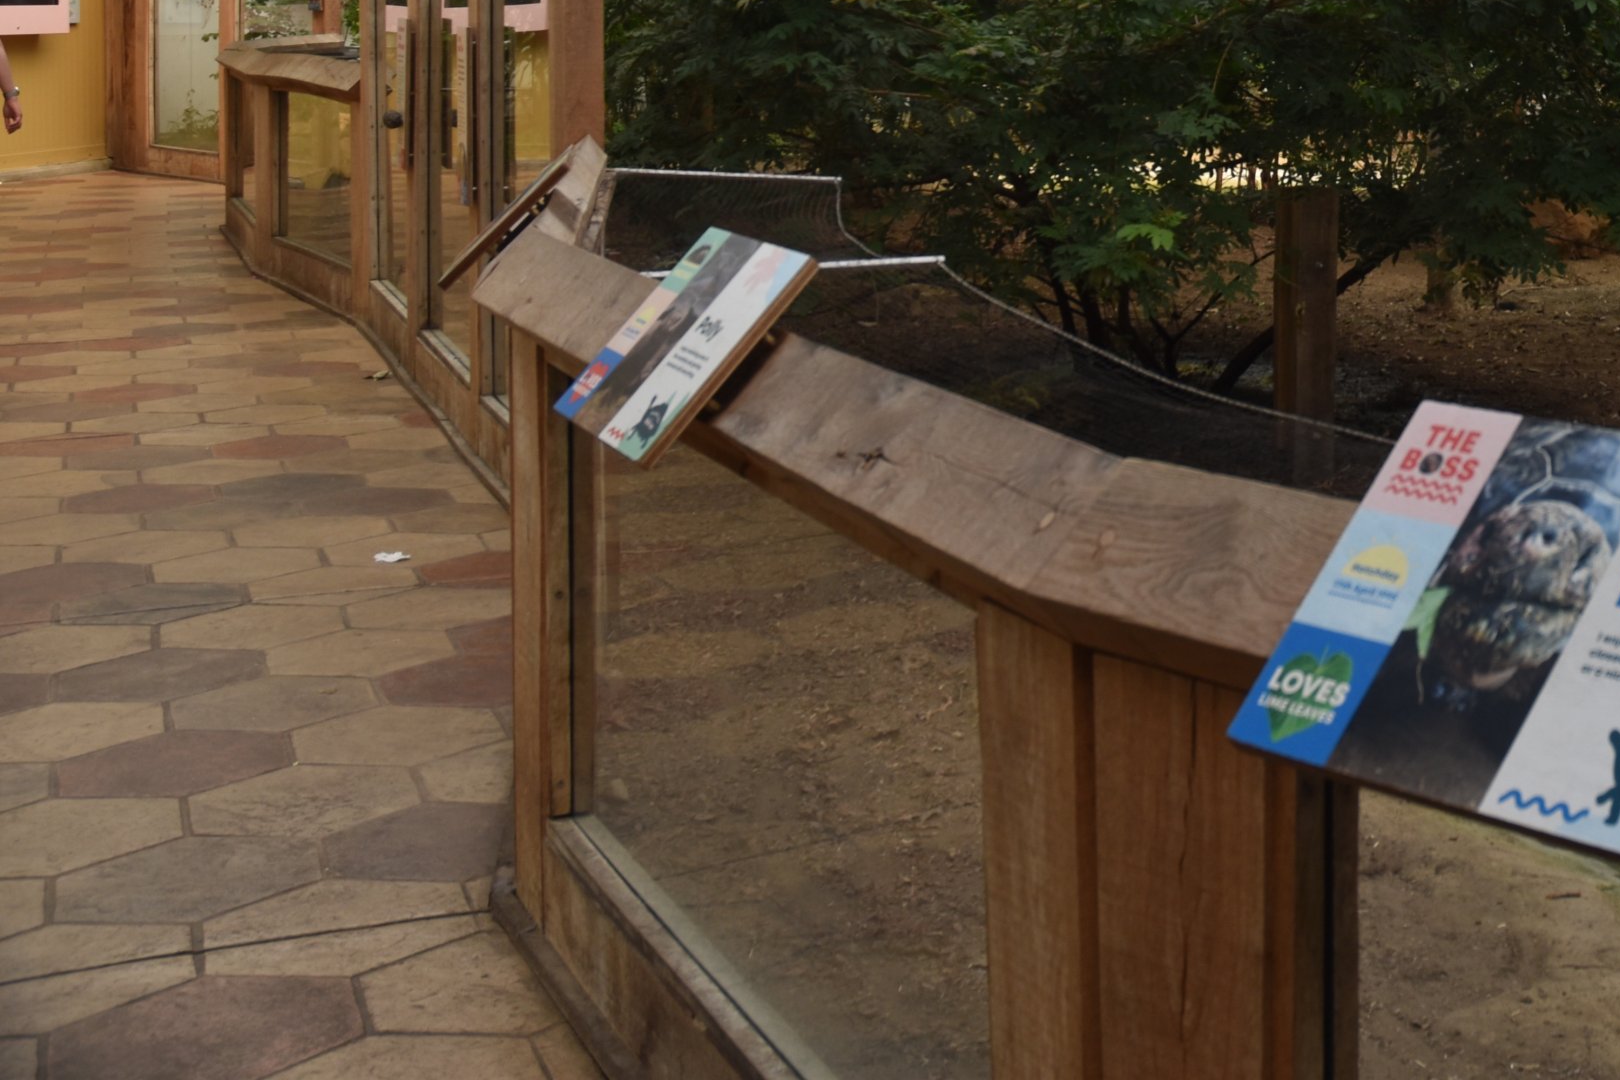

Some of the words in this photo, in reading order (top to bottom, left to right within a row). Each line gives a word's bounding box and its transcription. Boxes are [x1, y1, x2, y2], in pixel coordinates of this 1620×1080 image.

[1426, 425, 1481, 453] THE
[1400, 448, 1479, 482] BOSS
[1267, 665, 1350, 708] LOVES
[1580, 664, 1593, 675] or
[1257, 691, 1289, 713] LIME
[1288, 701, 1336, 725] LEAVES
